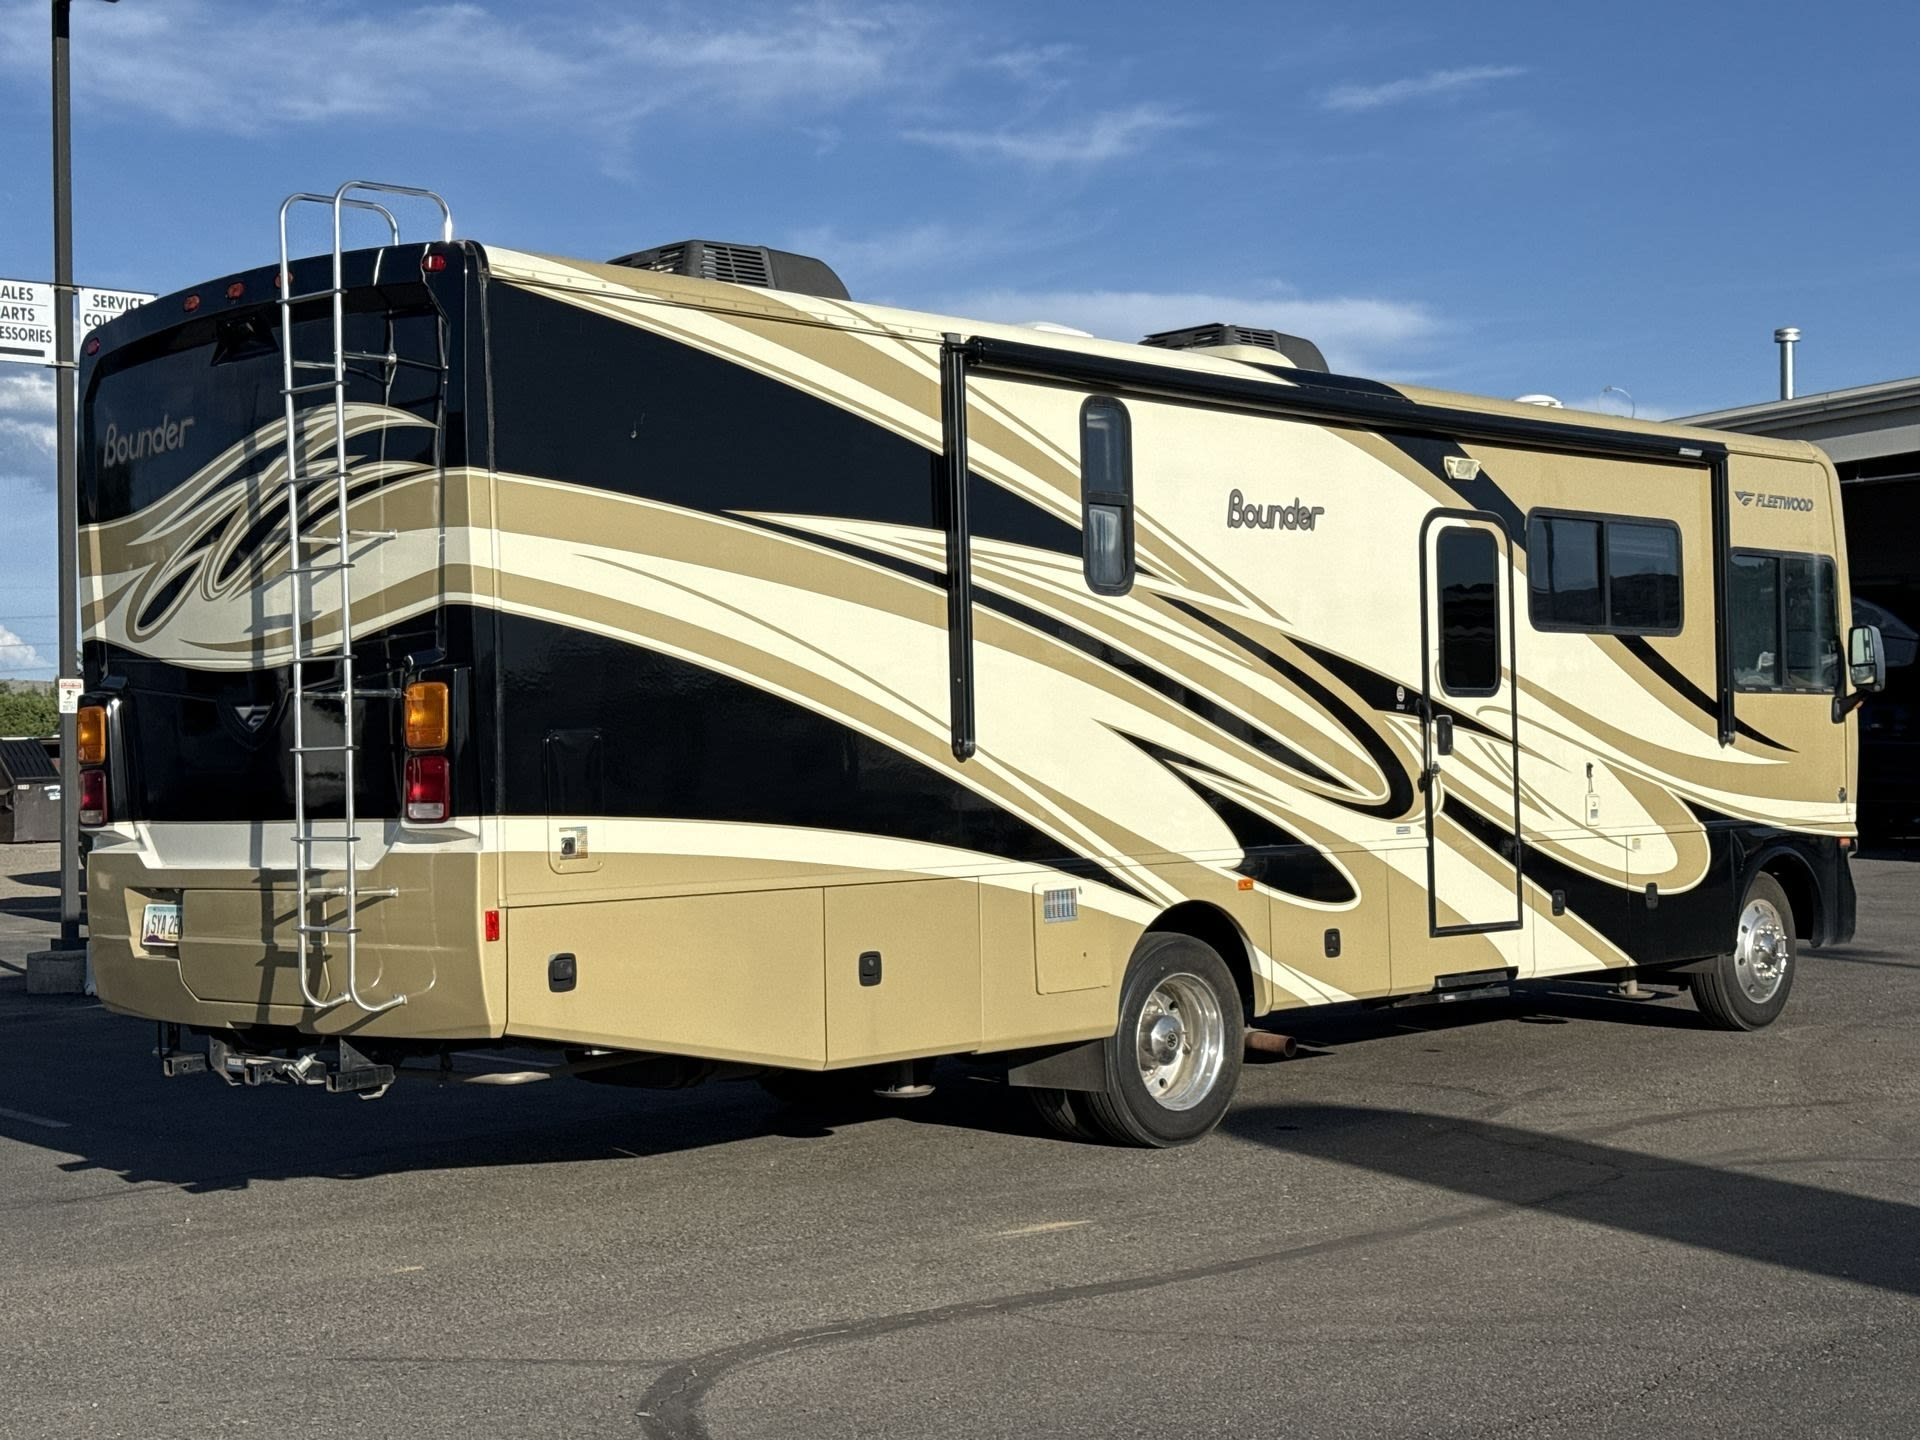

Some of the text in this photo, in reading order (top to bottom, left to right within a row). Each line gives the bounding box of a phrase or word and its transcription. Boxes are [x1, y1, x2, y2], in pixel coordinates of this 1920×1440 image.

[0, 285, 34, 301] ALES
[0, 305, 35, 322] ARTS
[103, 413, 195, 468] Bounder
[1226, 488, 1325, 531] Bounder
[1755, 493, 1814, 512] FLEETWOOD
